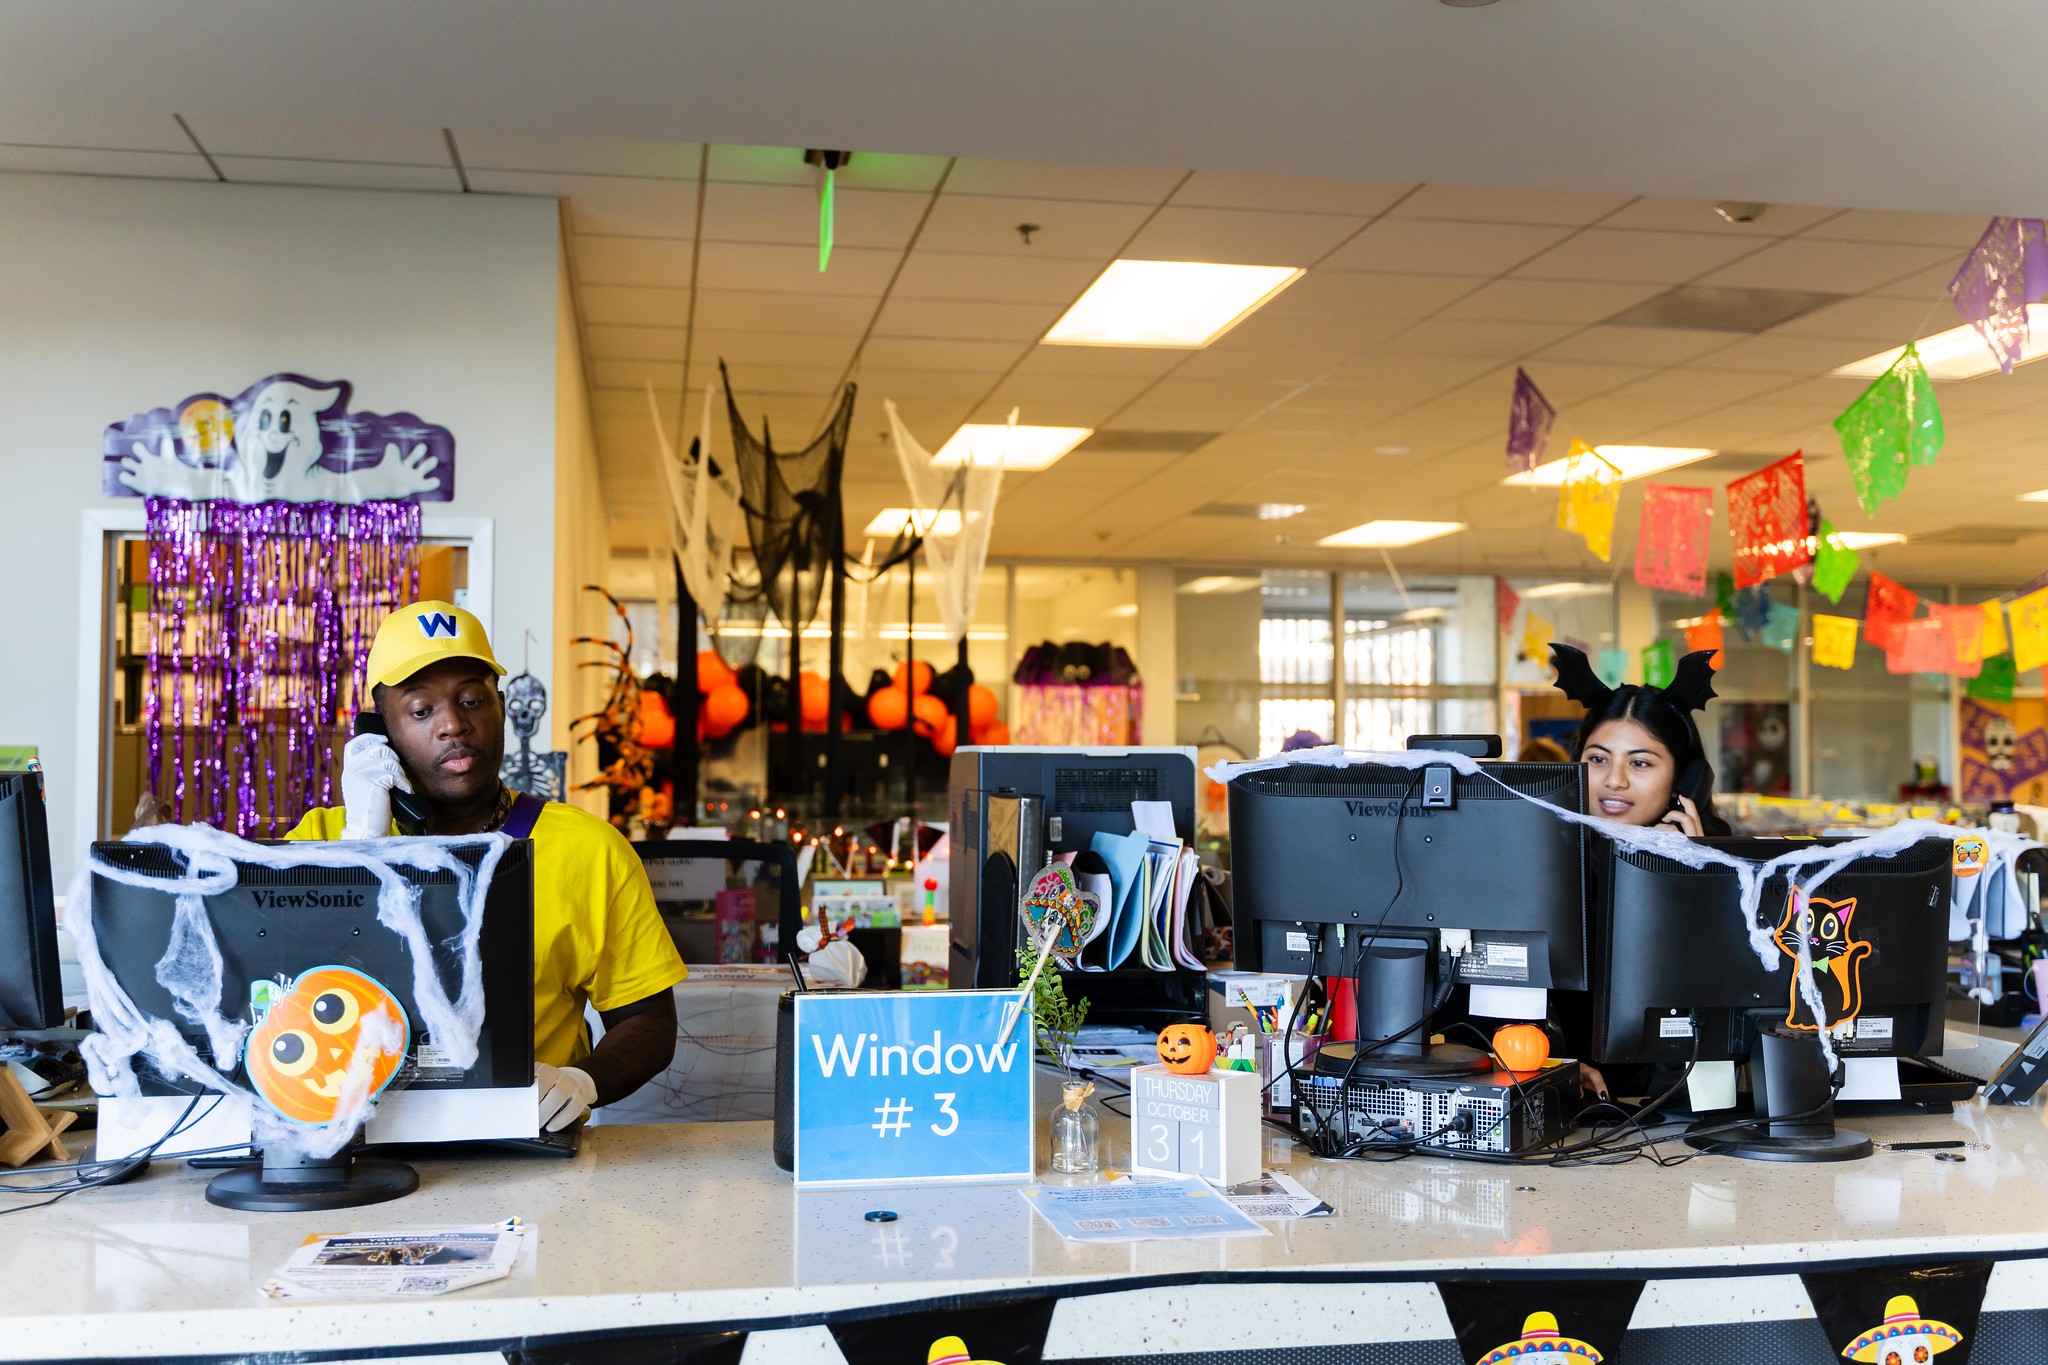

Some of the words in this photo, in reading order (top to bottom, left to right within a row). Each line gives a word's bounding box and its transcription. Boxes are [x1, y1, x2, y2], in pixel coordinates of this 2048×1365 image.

[417, 613, 456, 638] W
[251, 889, 365, 908] ViewSonic
[811, 1030, 1019, 1078] Window
[1143, 1077, 1212, 1104] THURSDAY
[871, 1097, 914, 1139] #
[930, 1092, 959, 1137] 3
[1147, 1101, 1210, 1124] OCTOBER
